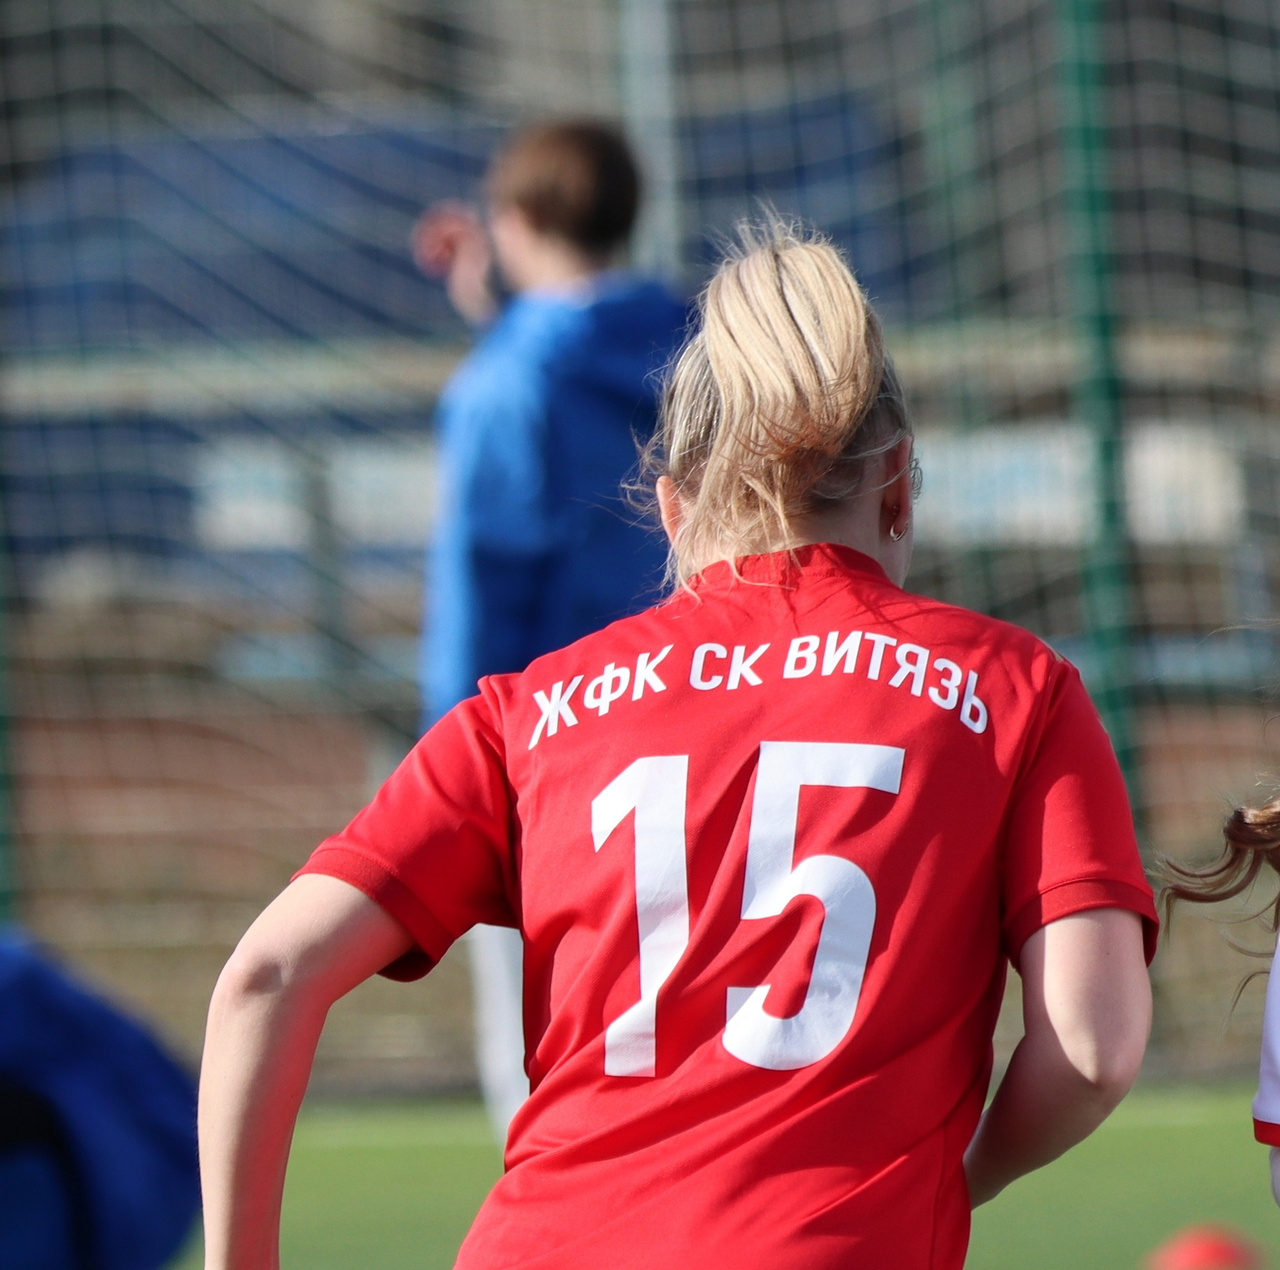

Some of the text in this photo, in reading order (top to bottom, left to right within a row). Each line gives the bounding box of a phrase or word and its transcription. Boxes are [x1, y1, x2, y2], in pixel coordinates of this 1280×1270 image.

[528, 631, 989, 750] ЖФК СК ВИТЯЗЬ
[591, 741, 906, 1077] 15
